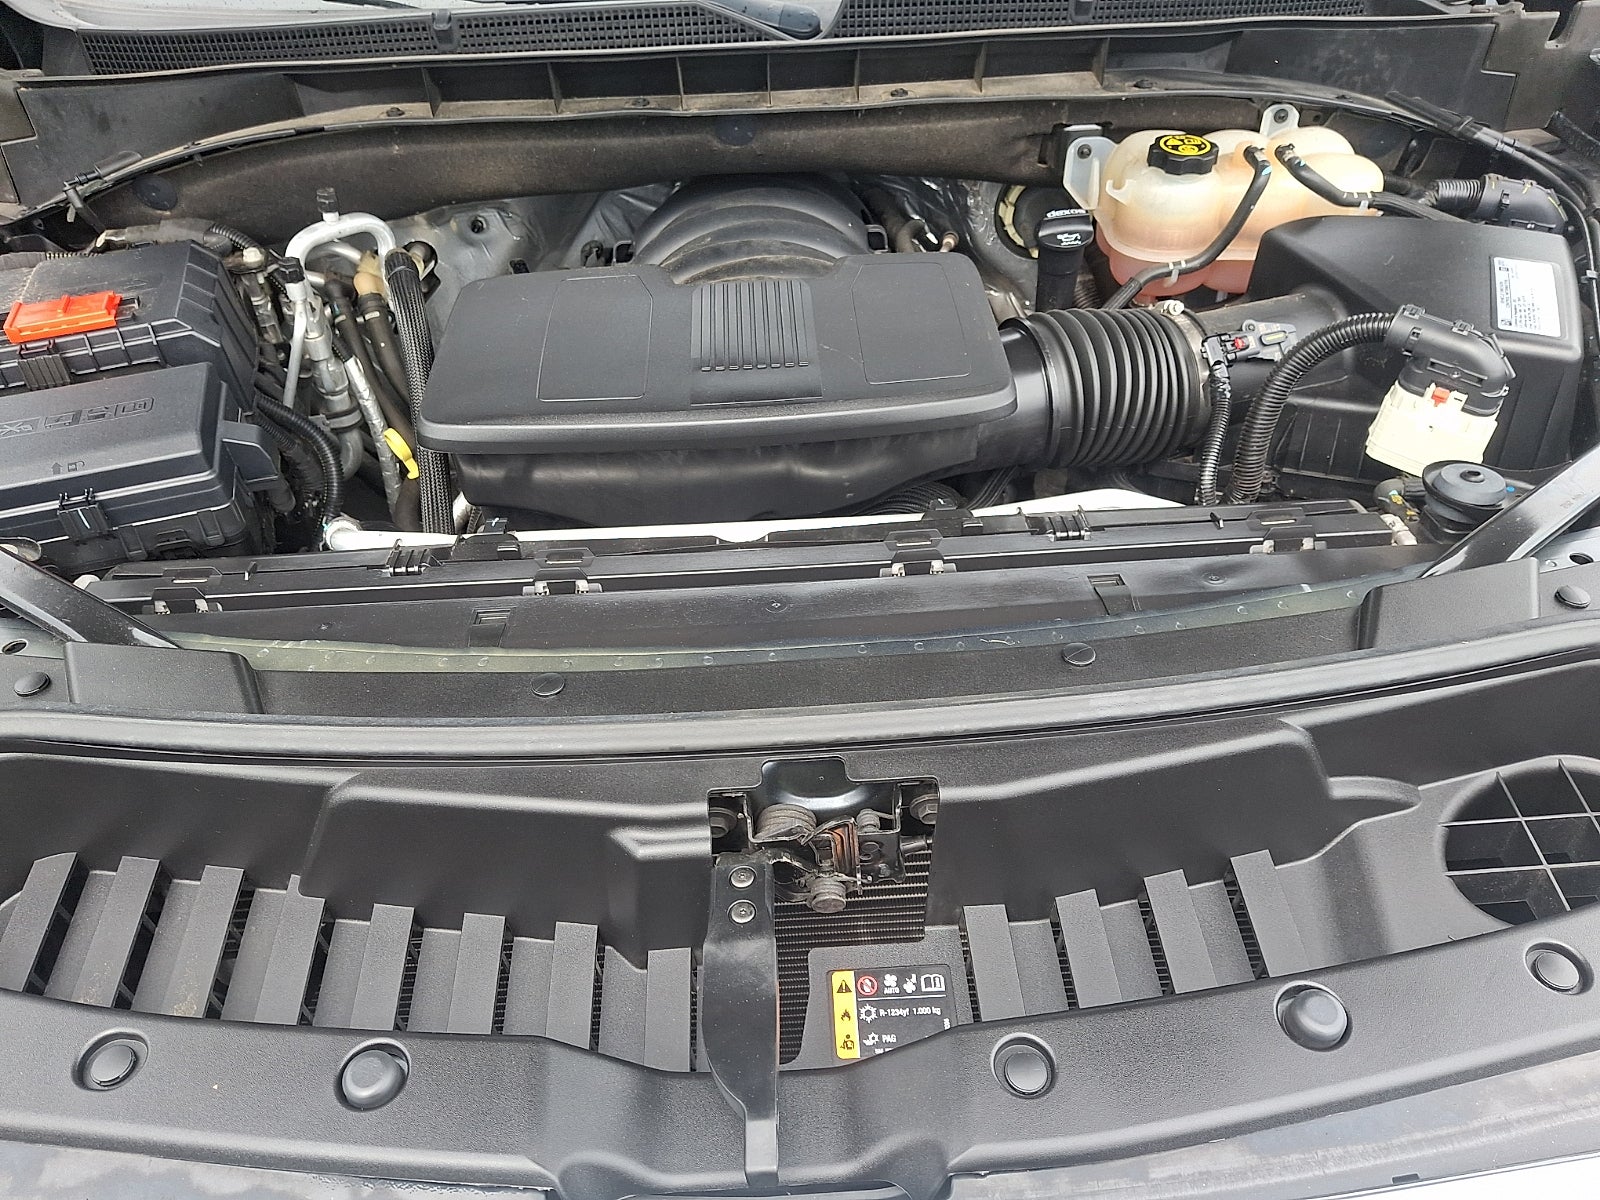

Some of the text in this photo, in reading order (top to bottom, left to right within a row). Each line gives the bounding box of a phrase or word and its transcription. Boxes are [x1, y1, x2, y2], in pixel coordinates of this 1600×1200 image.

[884, 987, 900, 995] AUTO
[879, 1007, 941, 1018] R-1234yf 1.000 kg
[881, 1034, 897, 1043] PAG
